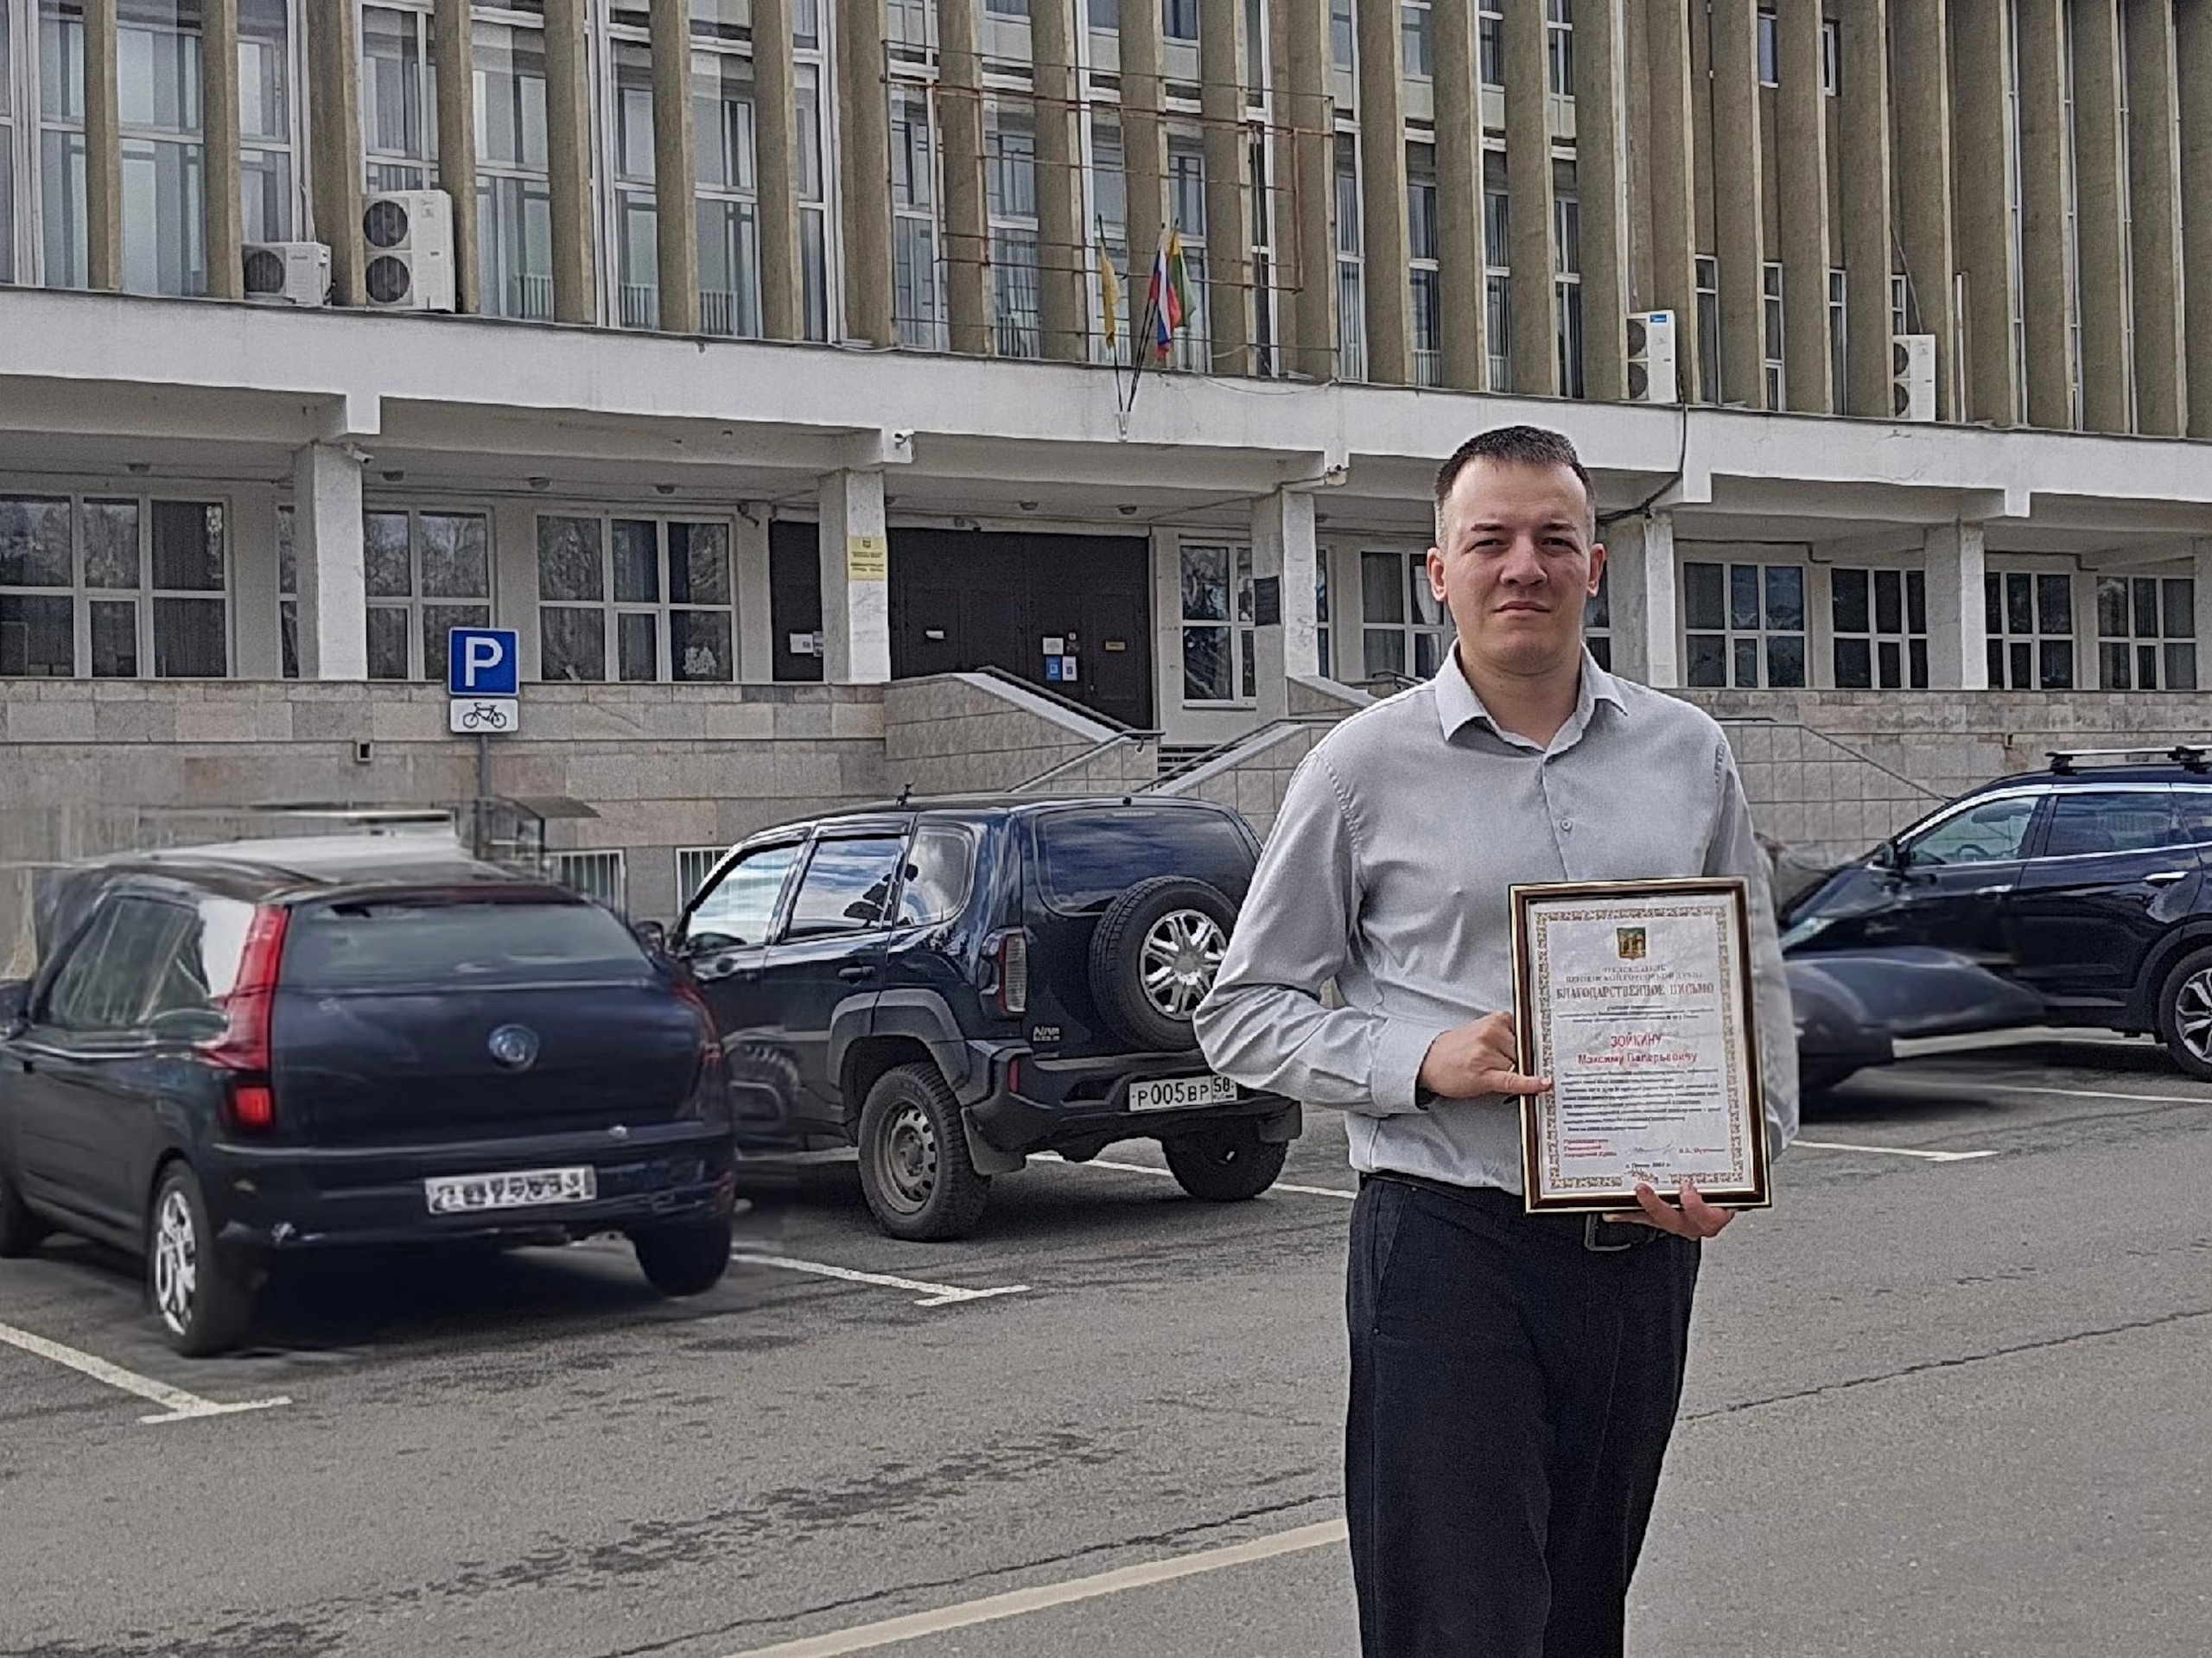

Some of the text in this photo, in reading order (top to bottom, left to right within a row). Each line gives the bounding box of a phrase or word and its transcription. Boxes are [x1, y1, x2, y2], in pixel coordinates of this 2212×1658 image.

[465, 636, 504, 687] P
[1611, 1032, 1662, 1047] ЗОЙКИНУ
[1578, 1054, 1624, 1065] Максиму
